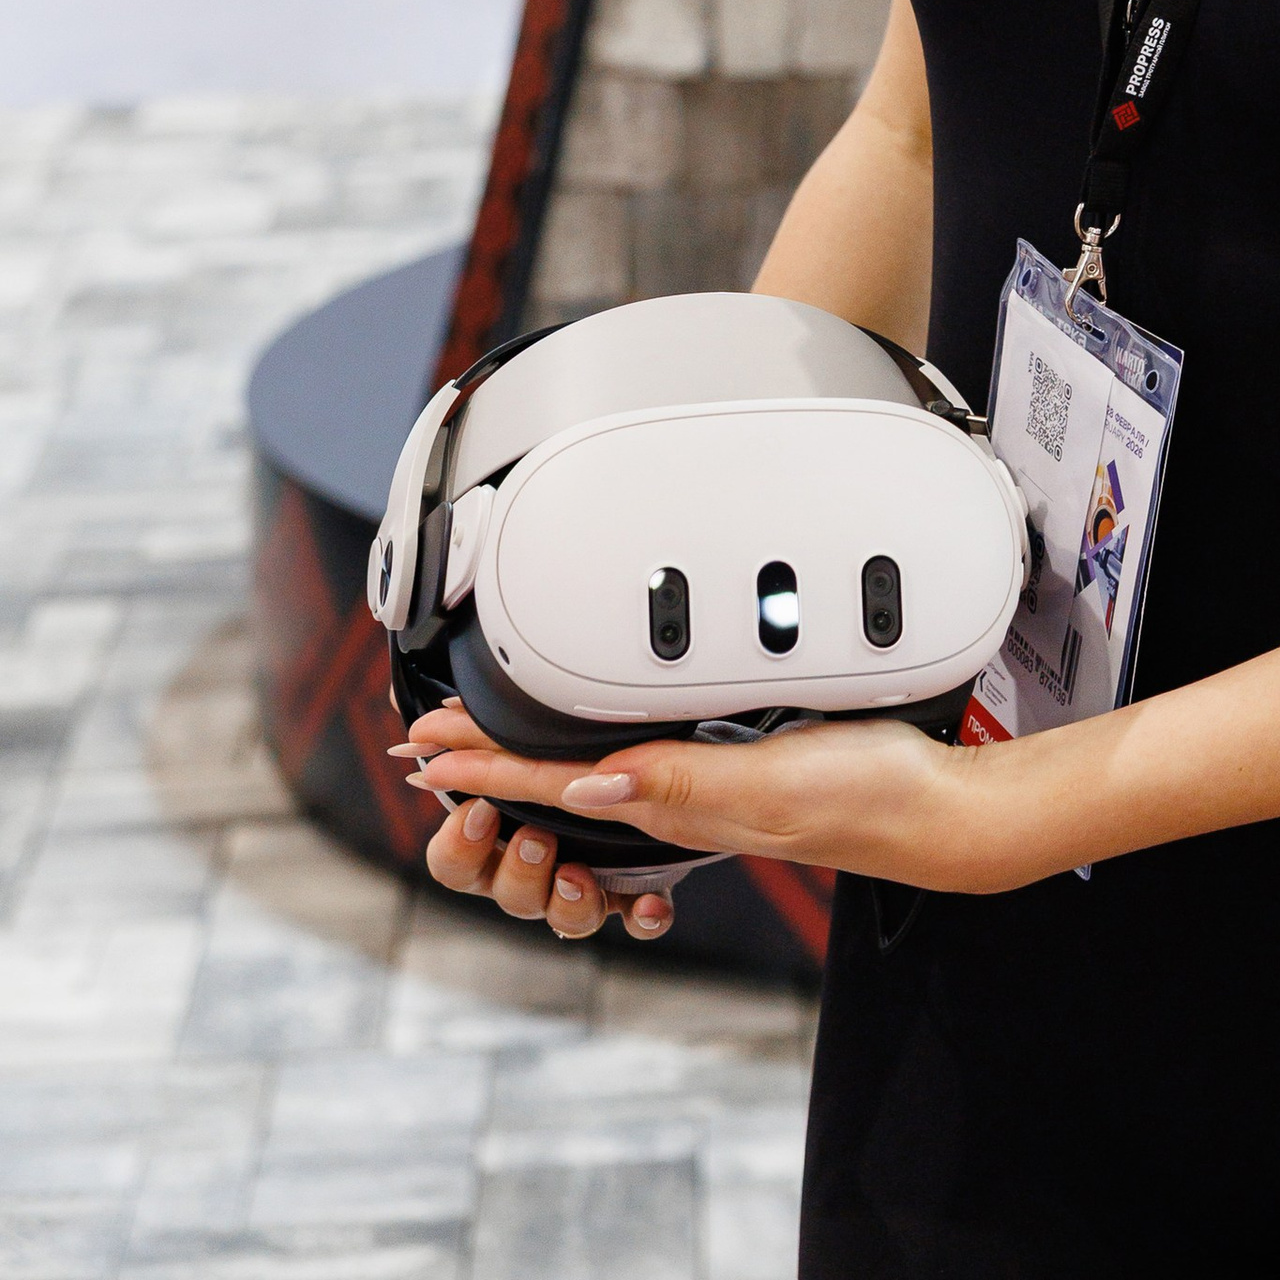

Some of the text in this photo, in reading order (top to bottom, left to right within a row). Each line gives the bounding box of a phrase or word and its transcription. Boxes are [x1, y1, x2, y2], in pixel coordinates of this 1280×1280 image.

[1125, 17, 1164, 95] PROPRESS
[1115, 413, 1145, 445] ФЕВРАЛЯ
[1126, 437, 1143, 459] 2026
[967, 715, 997, 745] ПРОМ
